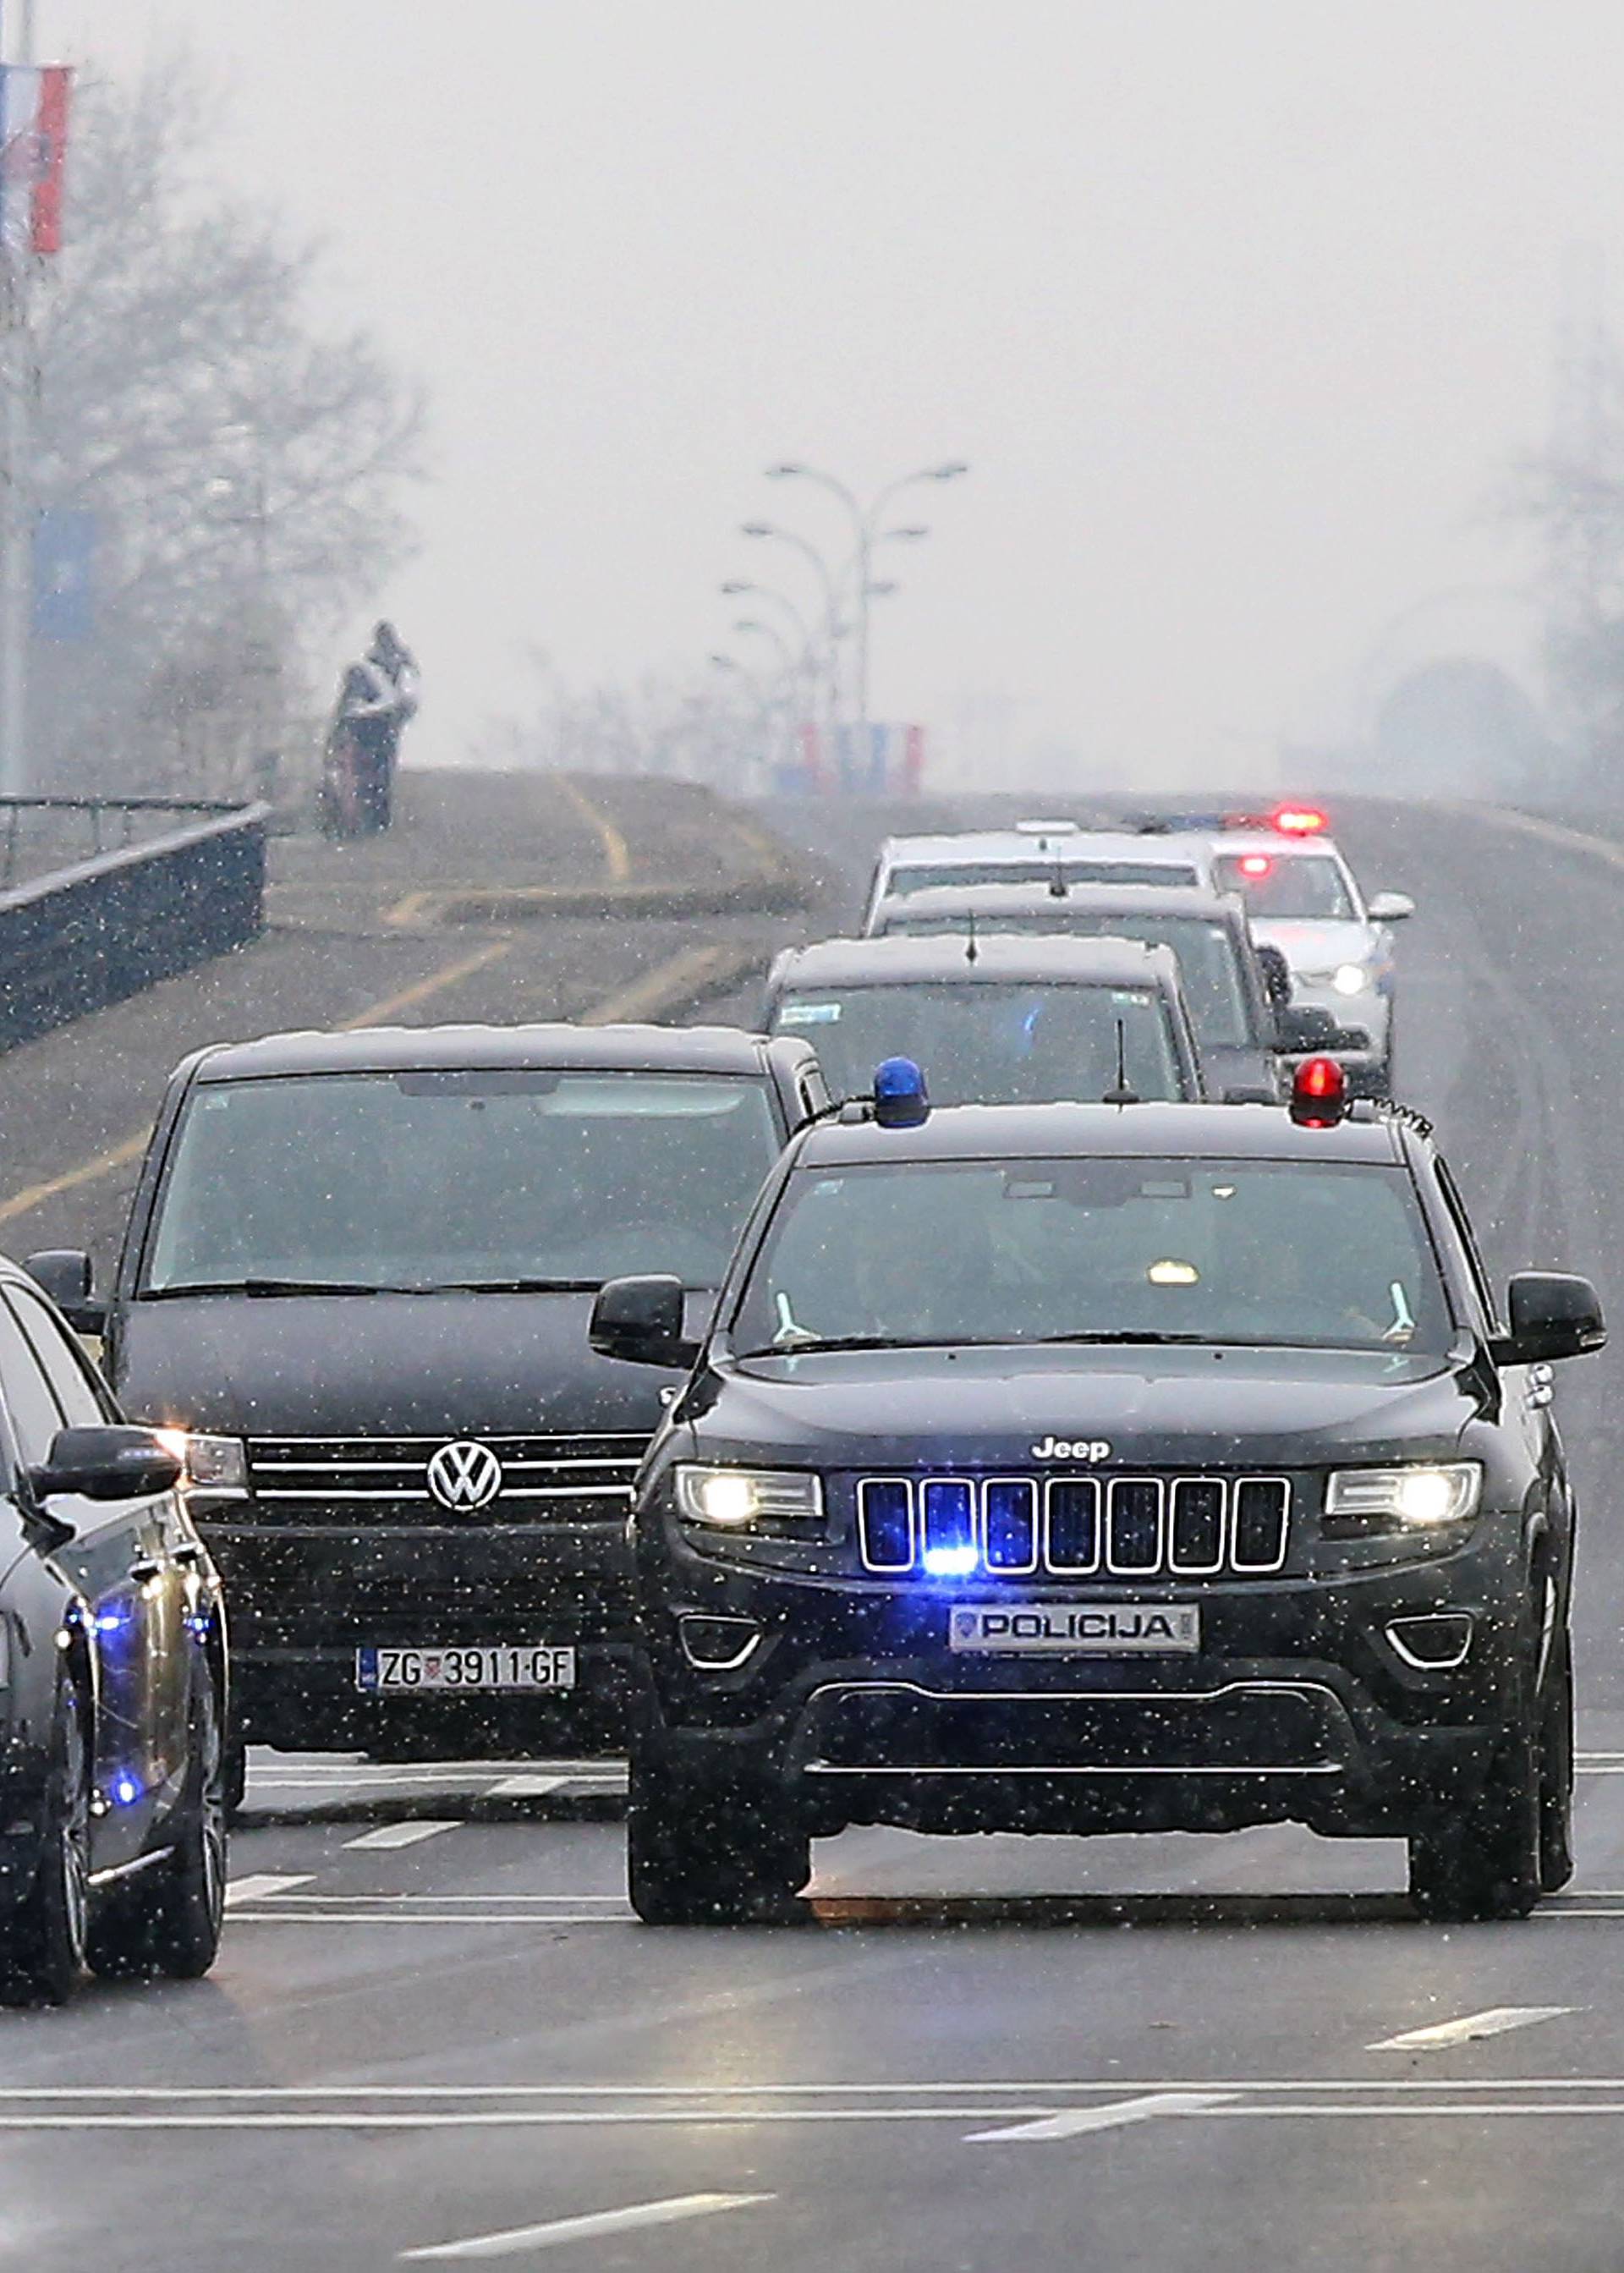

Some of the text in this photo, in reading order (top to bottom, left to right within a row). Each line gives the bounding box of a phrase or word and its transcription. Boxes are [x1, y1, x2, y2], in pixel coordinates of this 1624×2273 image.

[1032, 1436, 1110, 1463] Jeep
[430, 1443, 499, 1506] VW
[982, 1614, 1175, 1639] POLICIJA
[382, 1653, 421, 1685] ZG
